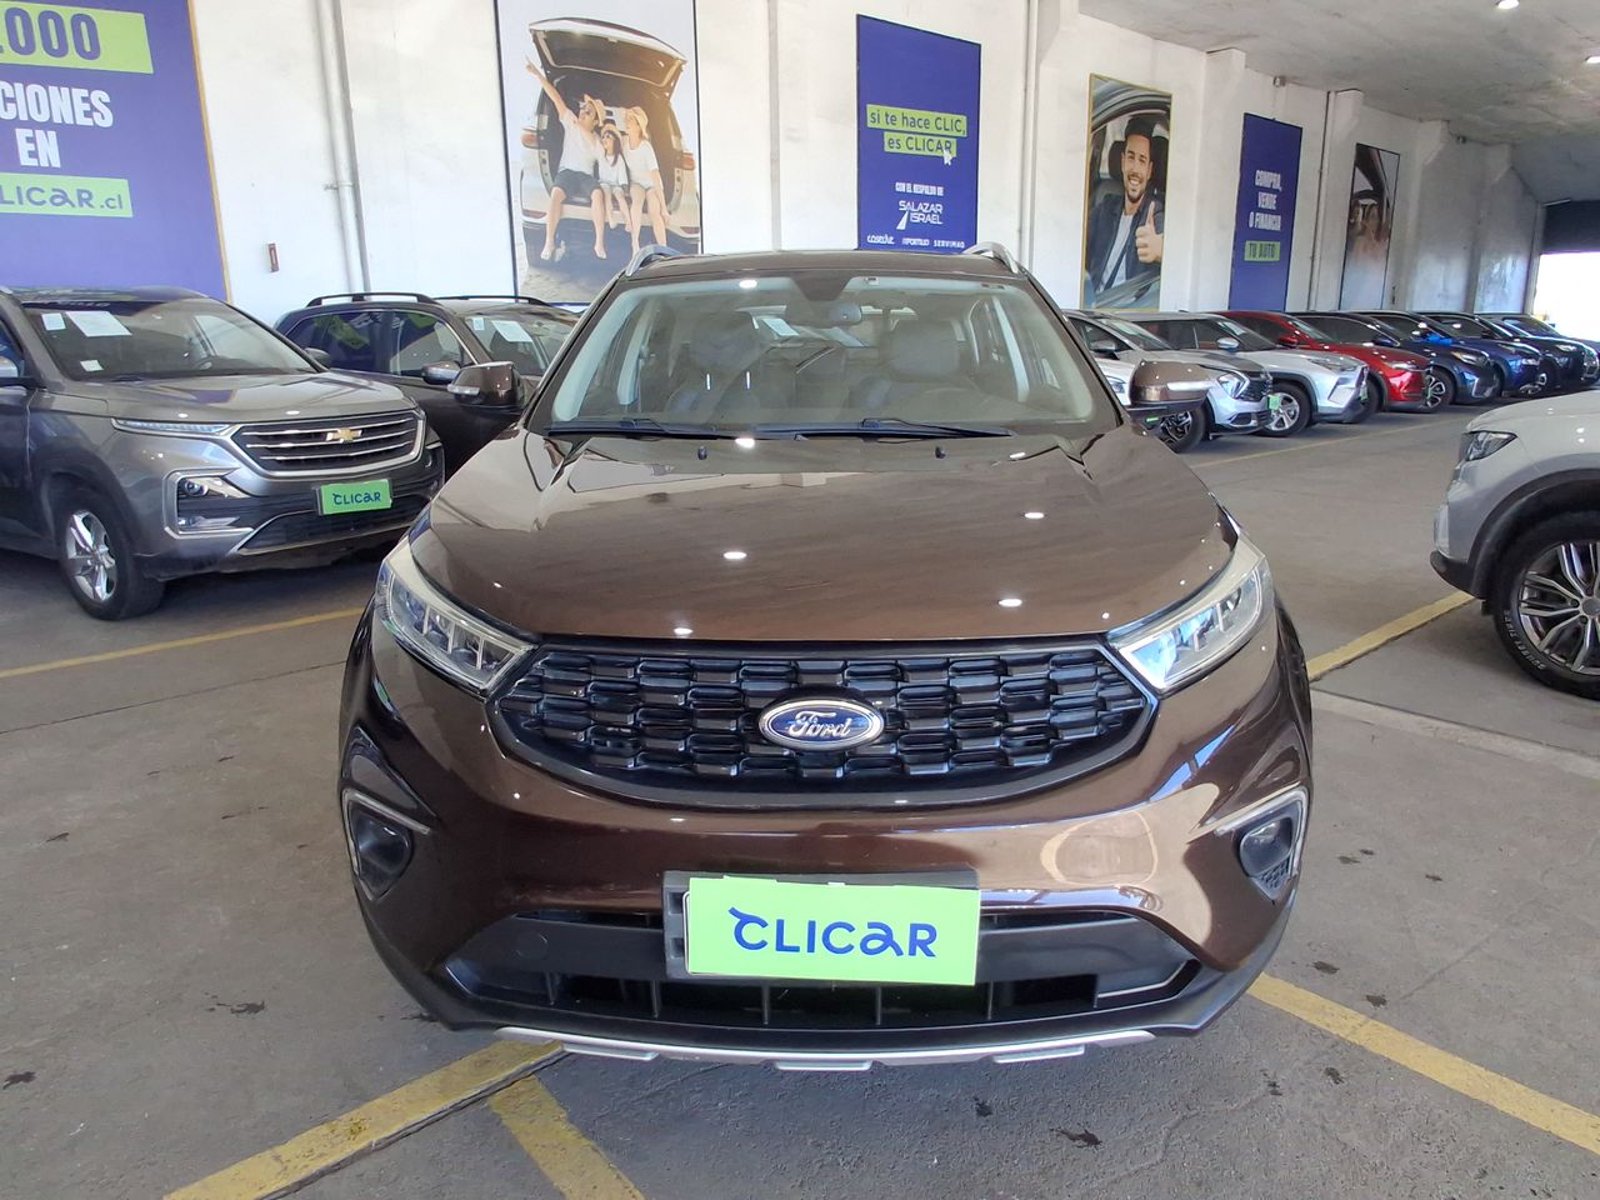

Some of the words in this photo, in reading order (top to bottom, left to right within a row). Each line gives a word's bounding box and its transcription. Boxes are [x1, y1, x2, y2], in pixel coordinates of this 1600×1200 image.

[870, 110, 881, 124] si
[884, 112, 897, 126] te
[901, 112, 931, 129] hace
[15, 128, 61, 168] EN
[887, 137, 901, 149] es
[905, 136, 952, 154] CLICAR
[898, 200, 944, 214] SALAZAR
[910, 212, 944, 225] ISRAEL
[785, 711, 853, 737] Ford
